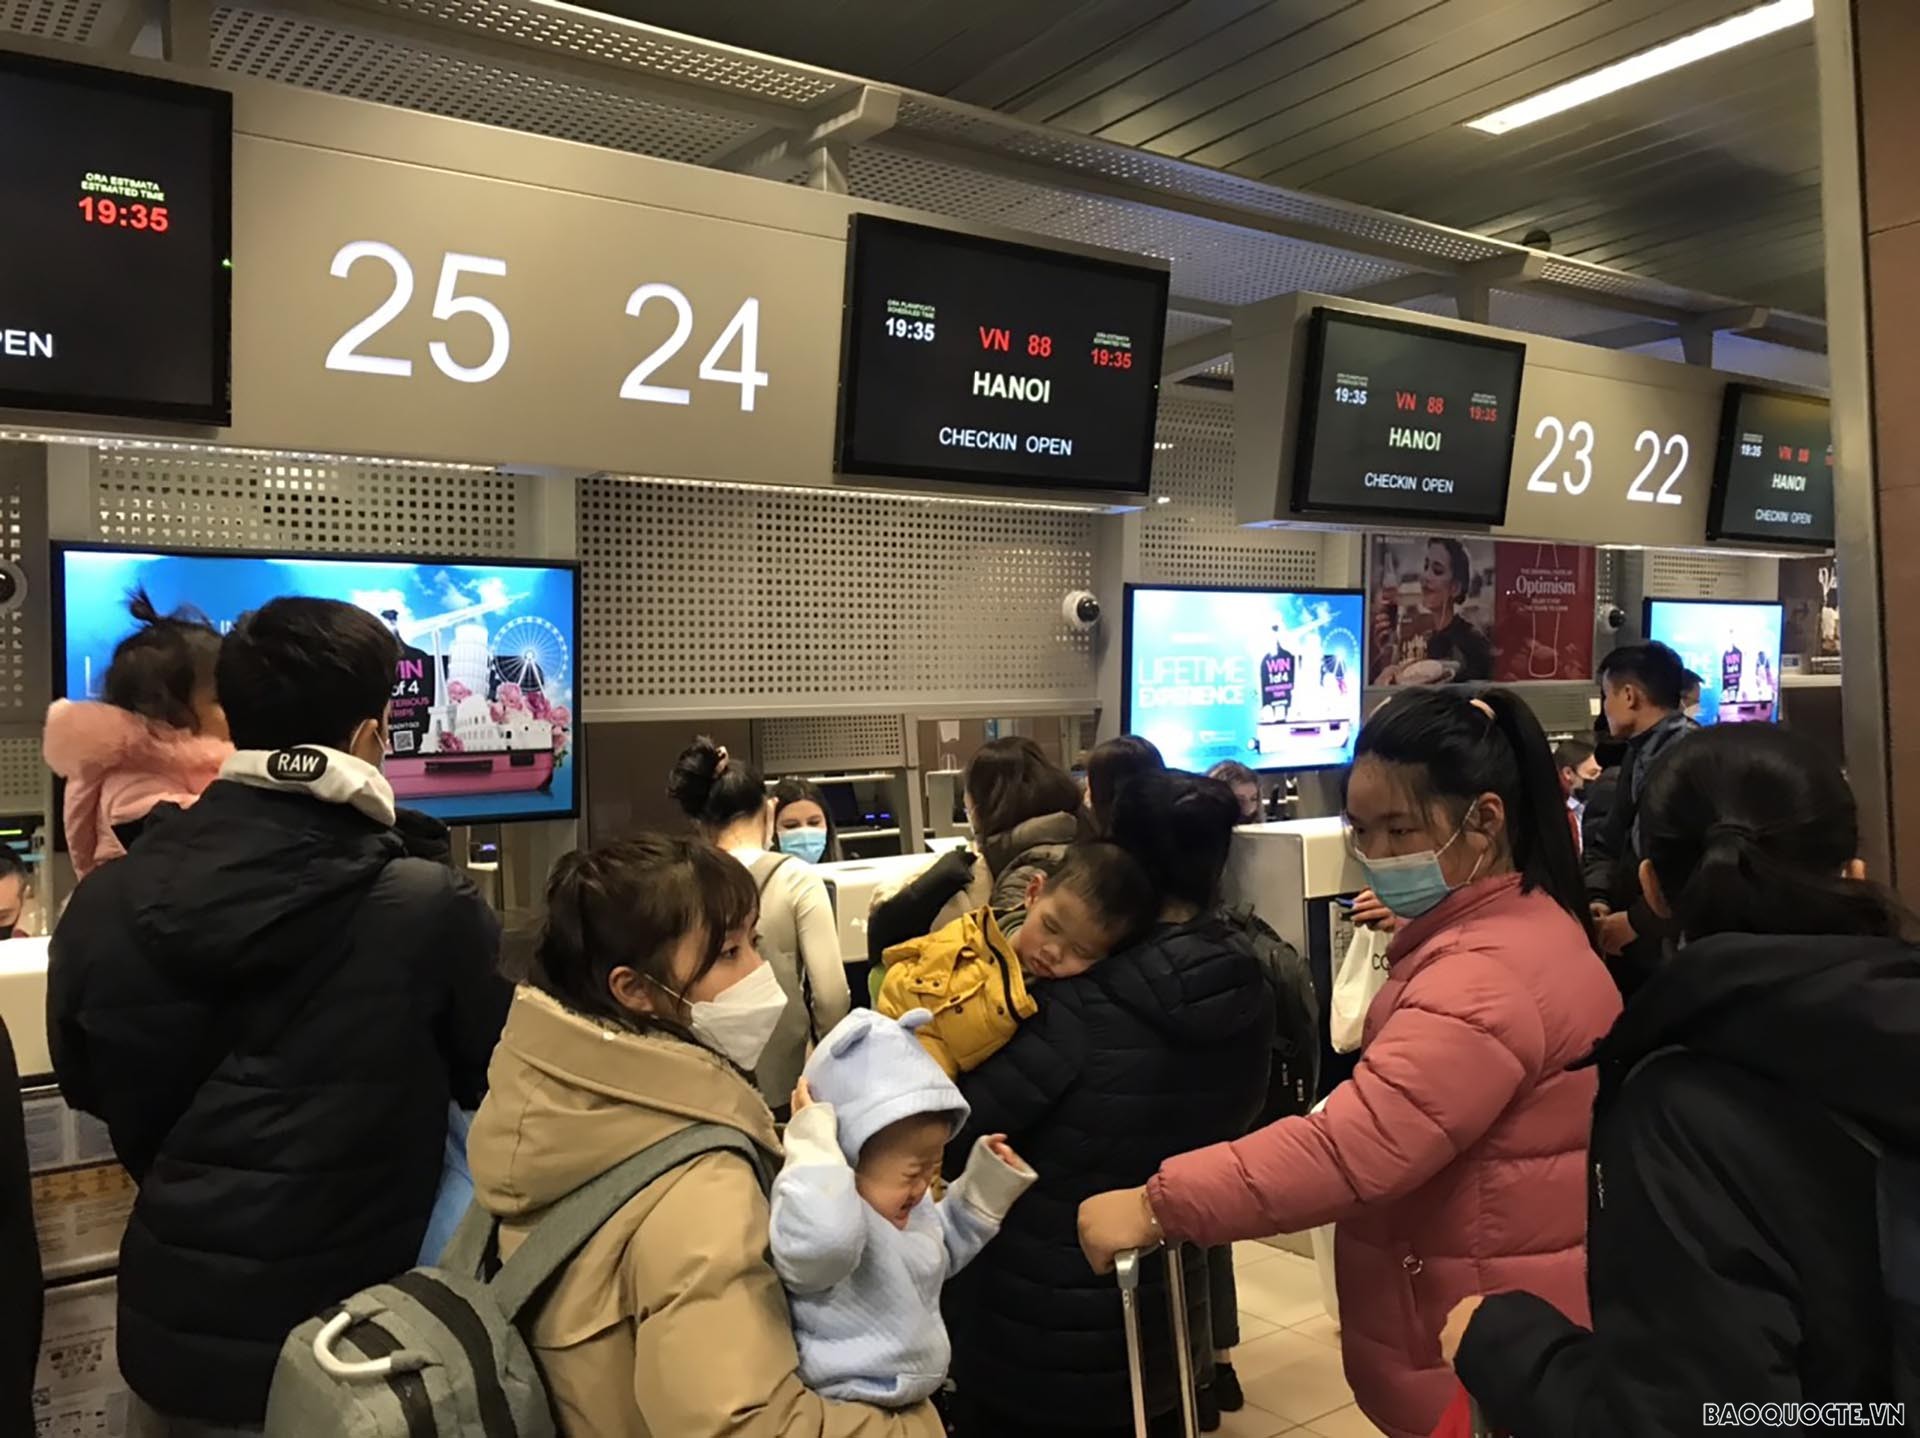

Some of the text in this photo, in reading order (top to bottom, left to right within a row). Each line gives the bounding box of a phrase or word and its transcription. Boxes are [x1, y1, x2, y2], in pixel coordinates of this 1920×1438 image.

[78, 196, 169, 233] 19:35
[325, 240, 510, 383] 25
[885, 317, 936, 342] 19:35
[979, 325, 1052, 357] VN 88
[0, 329, 53, 359] EN
[619, 282, 769, 412] 24
[1091, 348, 1133, 369] 19:35
[972, 370, 1051, 404] HANOI
[1334, 386, 1368, 405] 19:35
[1395, 391, 1416, 411] VN
[938, 426, 1073, 457] CHECKIN OPEN
[1388, 427, 1442, 452] HANOI
[1527, 416, 1594, 496] 23
[1626, 430, 1689, 505] 22
[1364, 472, 1454, 493] CHECKIN OPEN
[1771, 472, 1807, 492] HANOI
[1515, 574, 1577, 599] Optimism
[1266, 657, 1290, 672] WIN
[407, 679, 420, 695] 4
[277, 752, 320, 773] RAW
